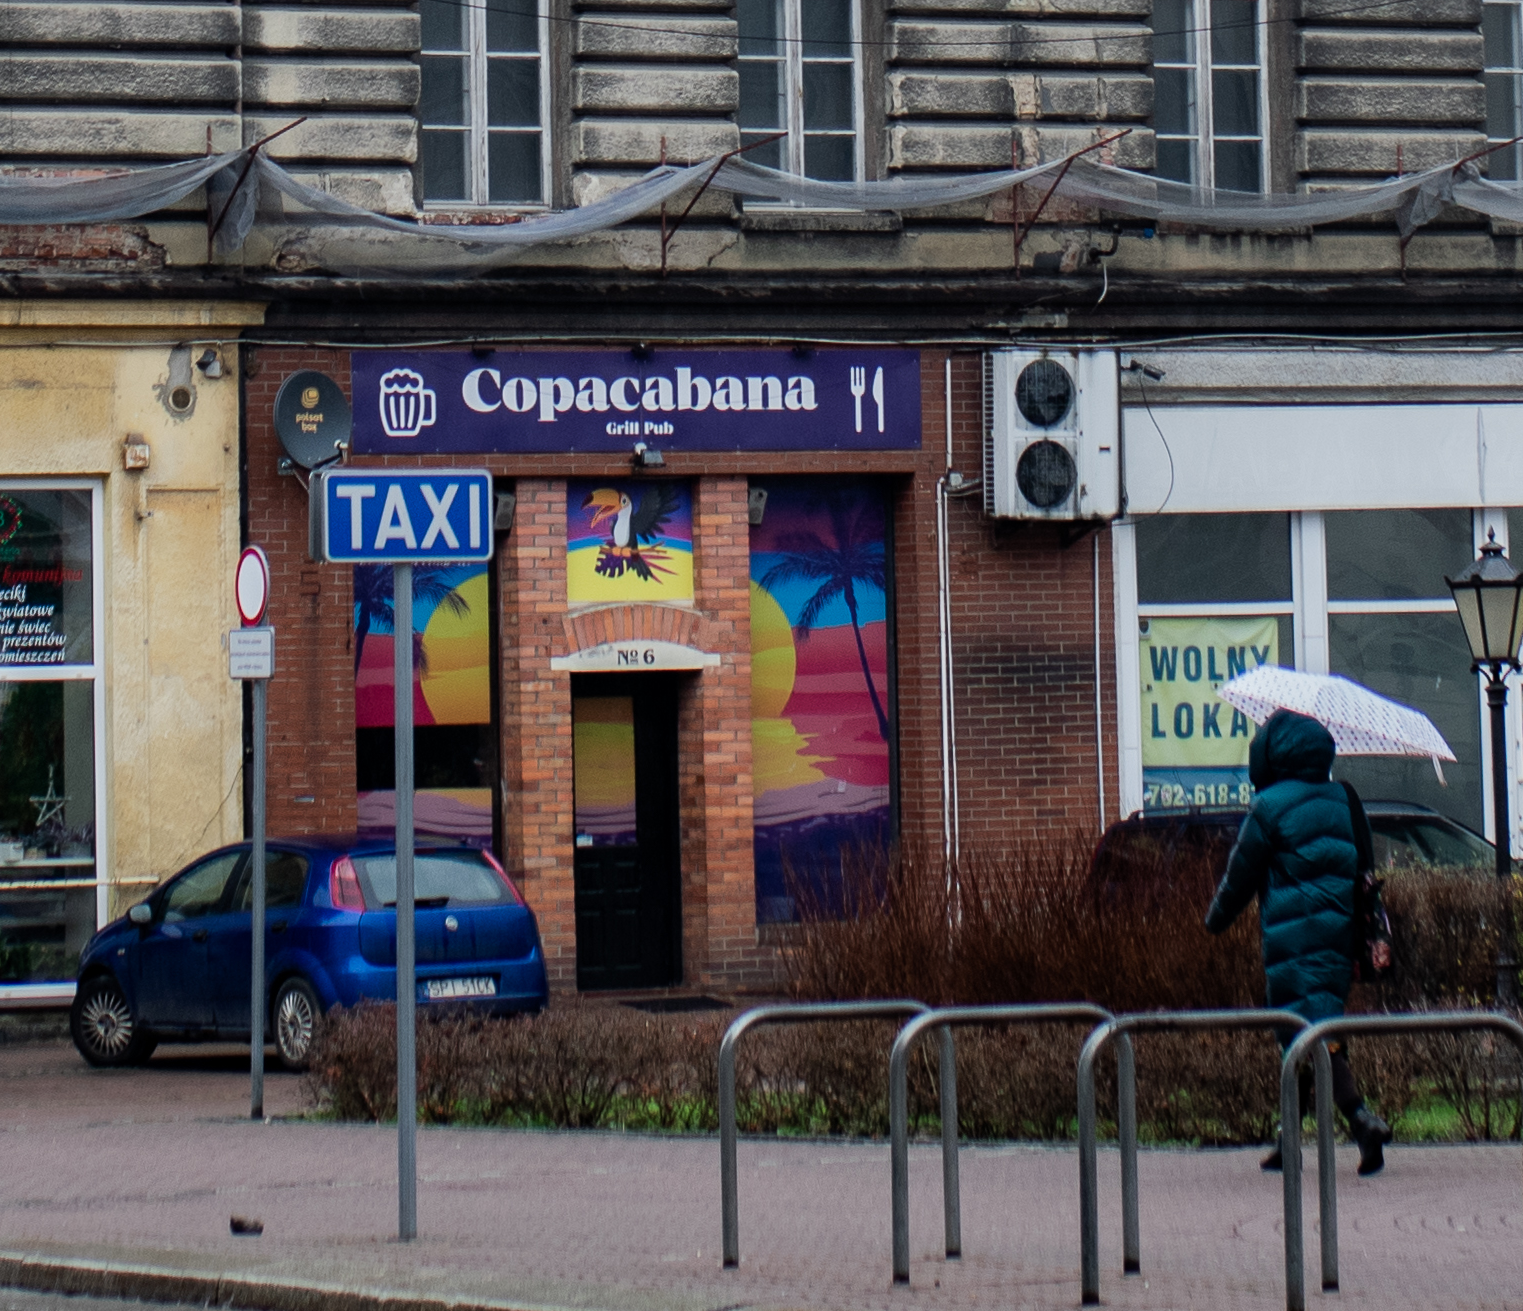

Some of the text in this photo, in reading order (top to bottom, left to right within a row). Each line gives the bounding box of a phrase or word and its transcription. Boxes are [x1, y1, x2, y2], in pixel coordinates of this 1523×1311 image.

[462, 366, 818, 422] Copacabana
[295, 412, 324, 424] polsat
[301, 421, 318, 433] box
[606, 420, 674, 435] Grill Pub
[336, 483, 481, 550] TAXI
[17, 619, 51, 635] świec
[3, 632, 67, 652] prezentów
[643, 648, 655, 665] 6
[1149, 645, 1270, 682] WOLNY
[1151, 701, 1249, 739] LOKA
